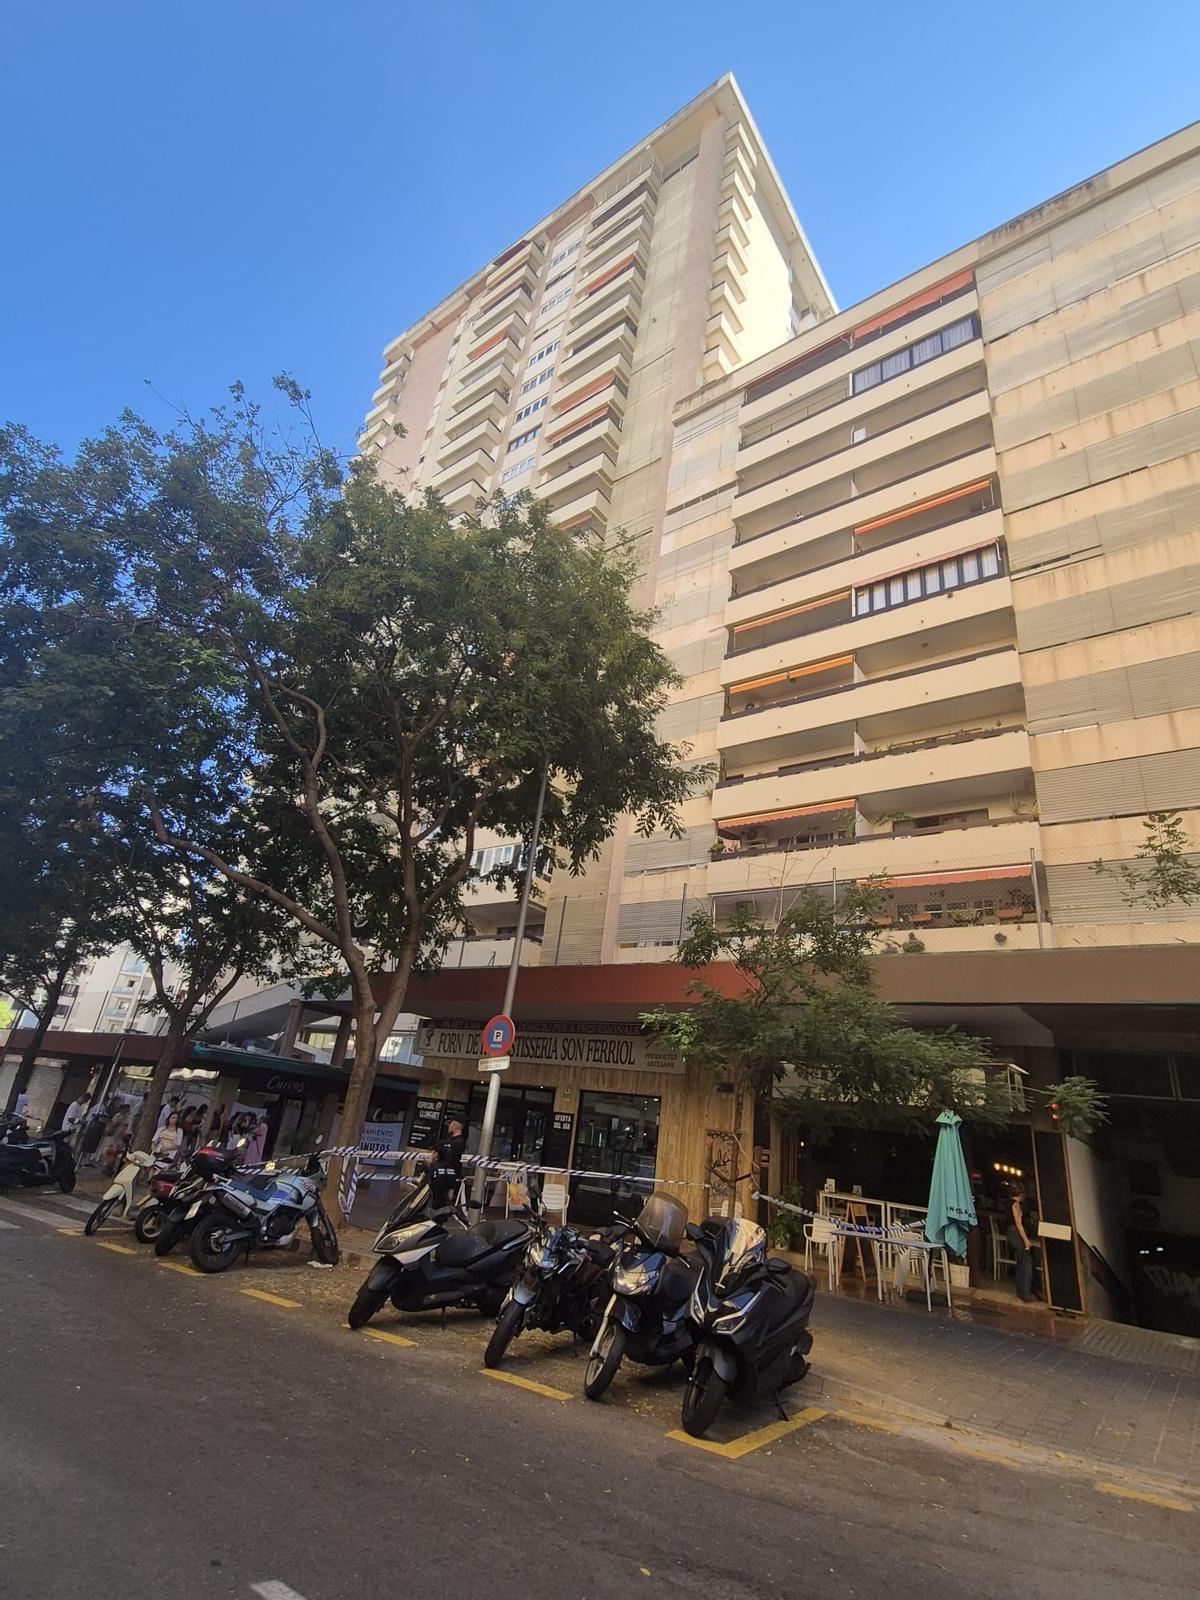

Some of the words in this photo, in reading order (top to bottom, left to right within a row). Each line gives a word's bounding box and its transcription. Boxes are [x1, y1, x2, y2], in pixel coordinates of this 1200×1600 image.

[495, 1031, 501, 1040] P
[437, 1032, 465, 1053] FORN
[465, 1033, 481, 1055] DE
[560, 1038, 585, 1061] SON
[586, 1039, 636, 1065] FERRIOL
[554, 1114, 572, 1123] OFERTA
